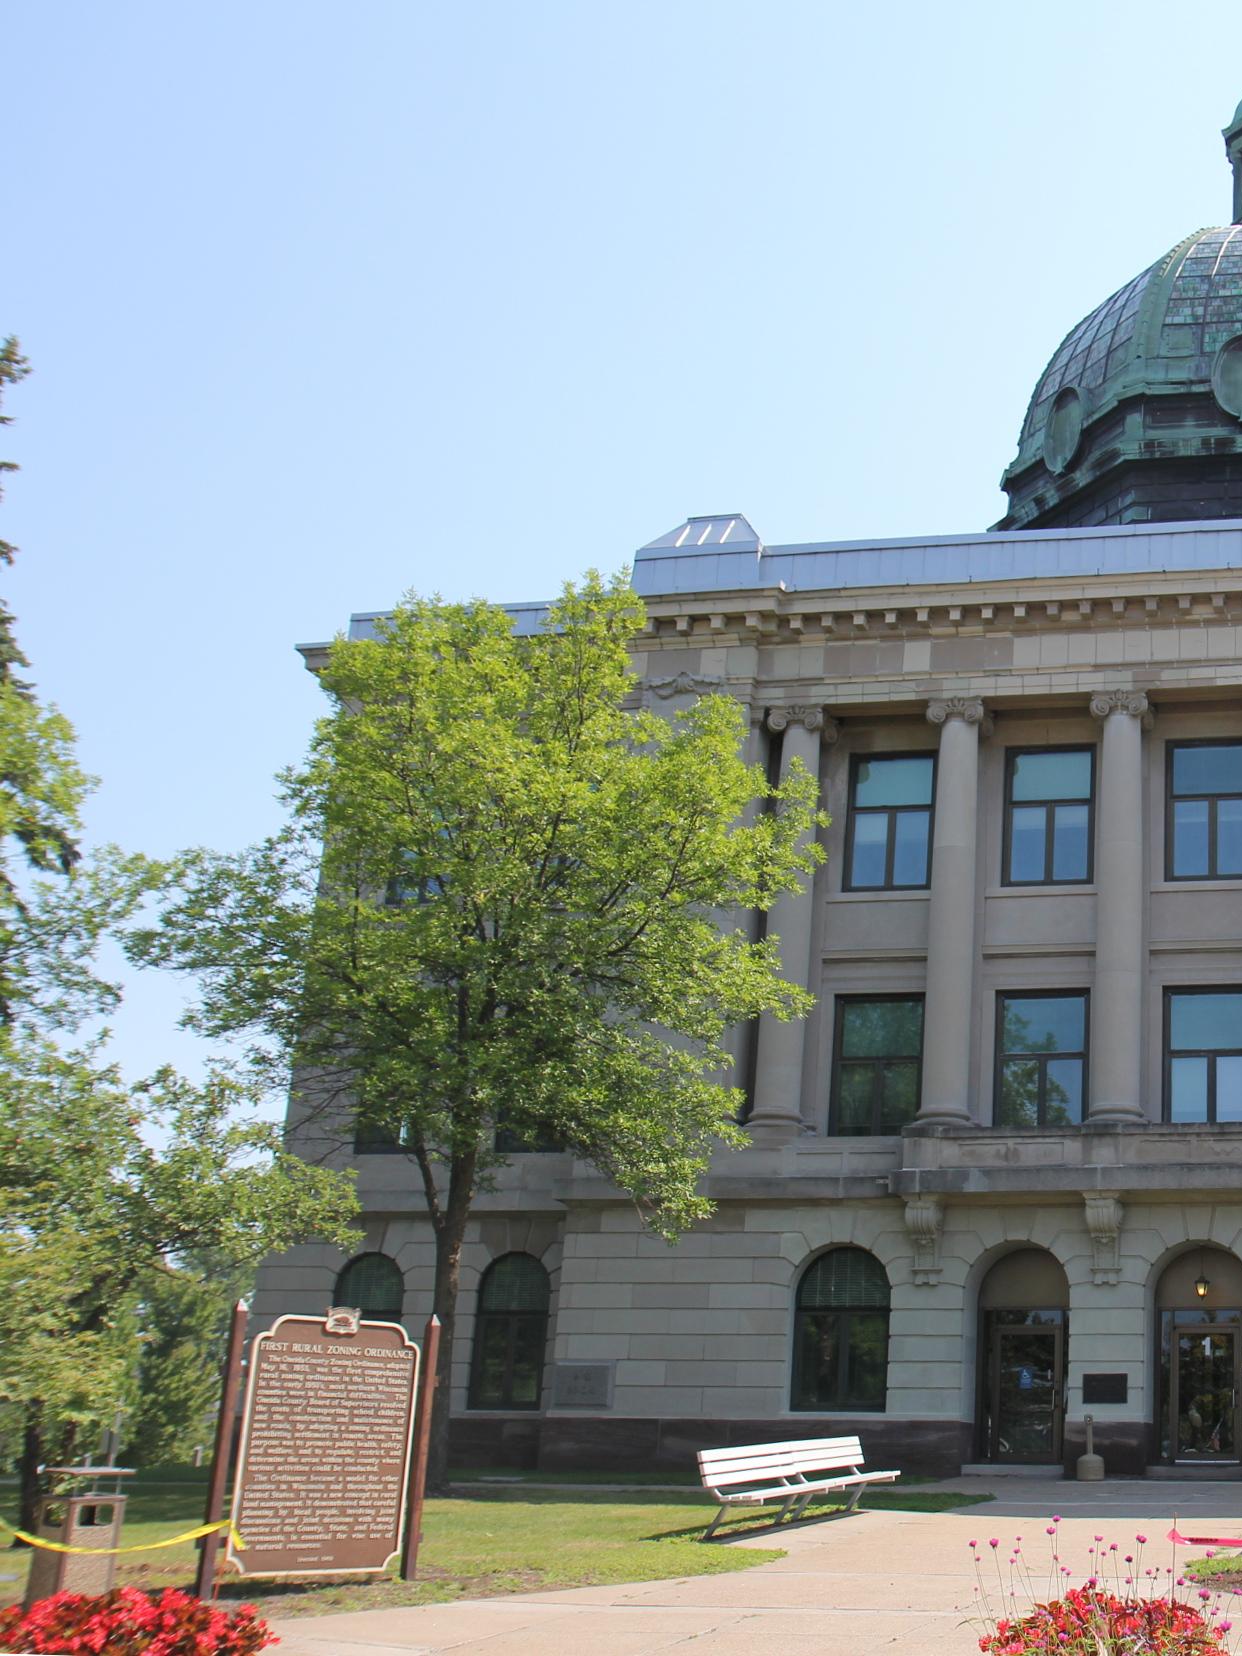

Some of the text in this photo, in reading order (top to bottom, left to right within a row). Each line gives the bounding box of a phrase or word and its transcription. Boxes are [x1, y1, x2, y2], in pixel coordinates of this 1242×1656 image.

[260, 1342, 414, 1359] FIRST RURAL ZONING ORDINANCE
